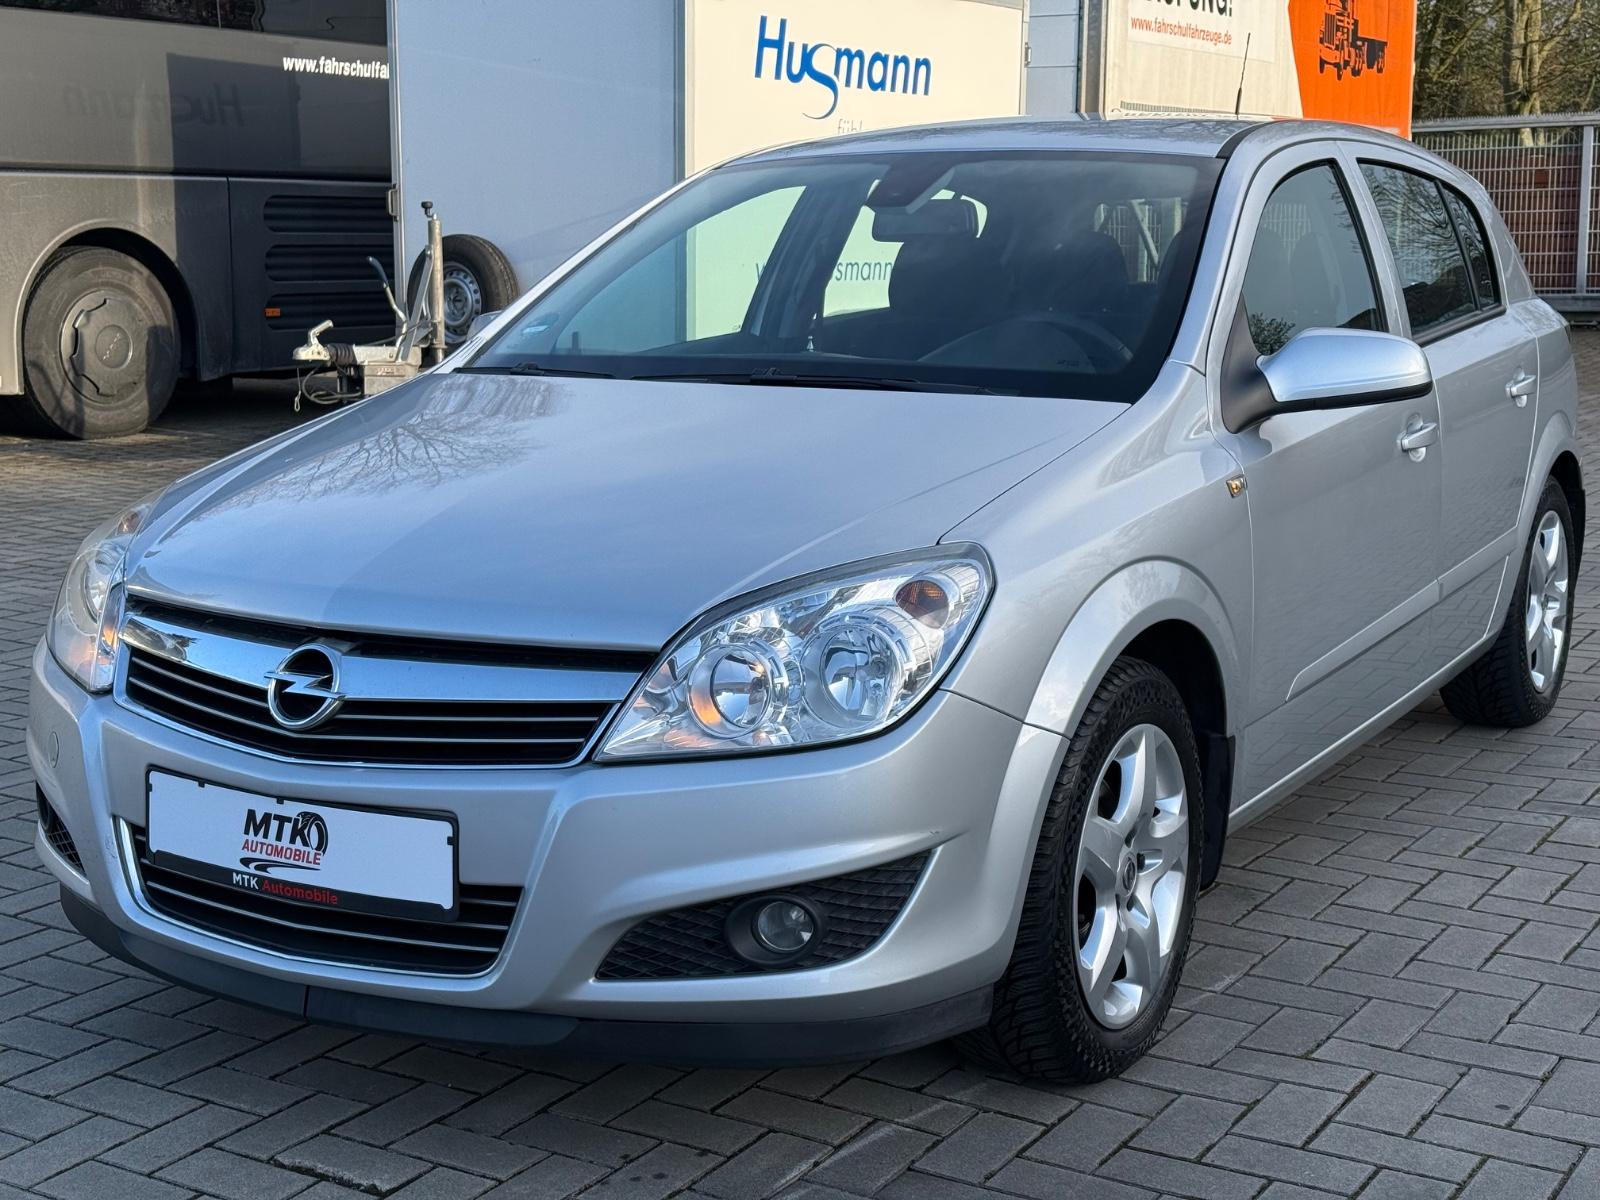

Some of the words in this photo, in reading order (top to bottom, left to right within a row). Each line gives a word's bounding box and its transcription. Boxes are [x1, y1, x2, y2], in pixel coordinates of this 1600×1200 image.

[1131, 17, 1232, 46] www.fahrschulfahrzeuge.de
[243, 808, 310, 848] MTK
[241, 838, 321, 866] AUTOMOBILE
[232, 872, 259, 890] MTK
[262, 880, 338, 904] Automobile
